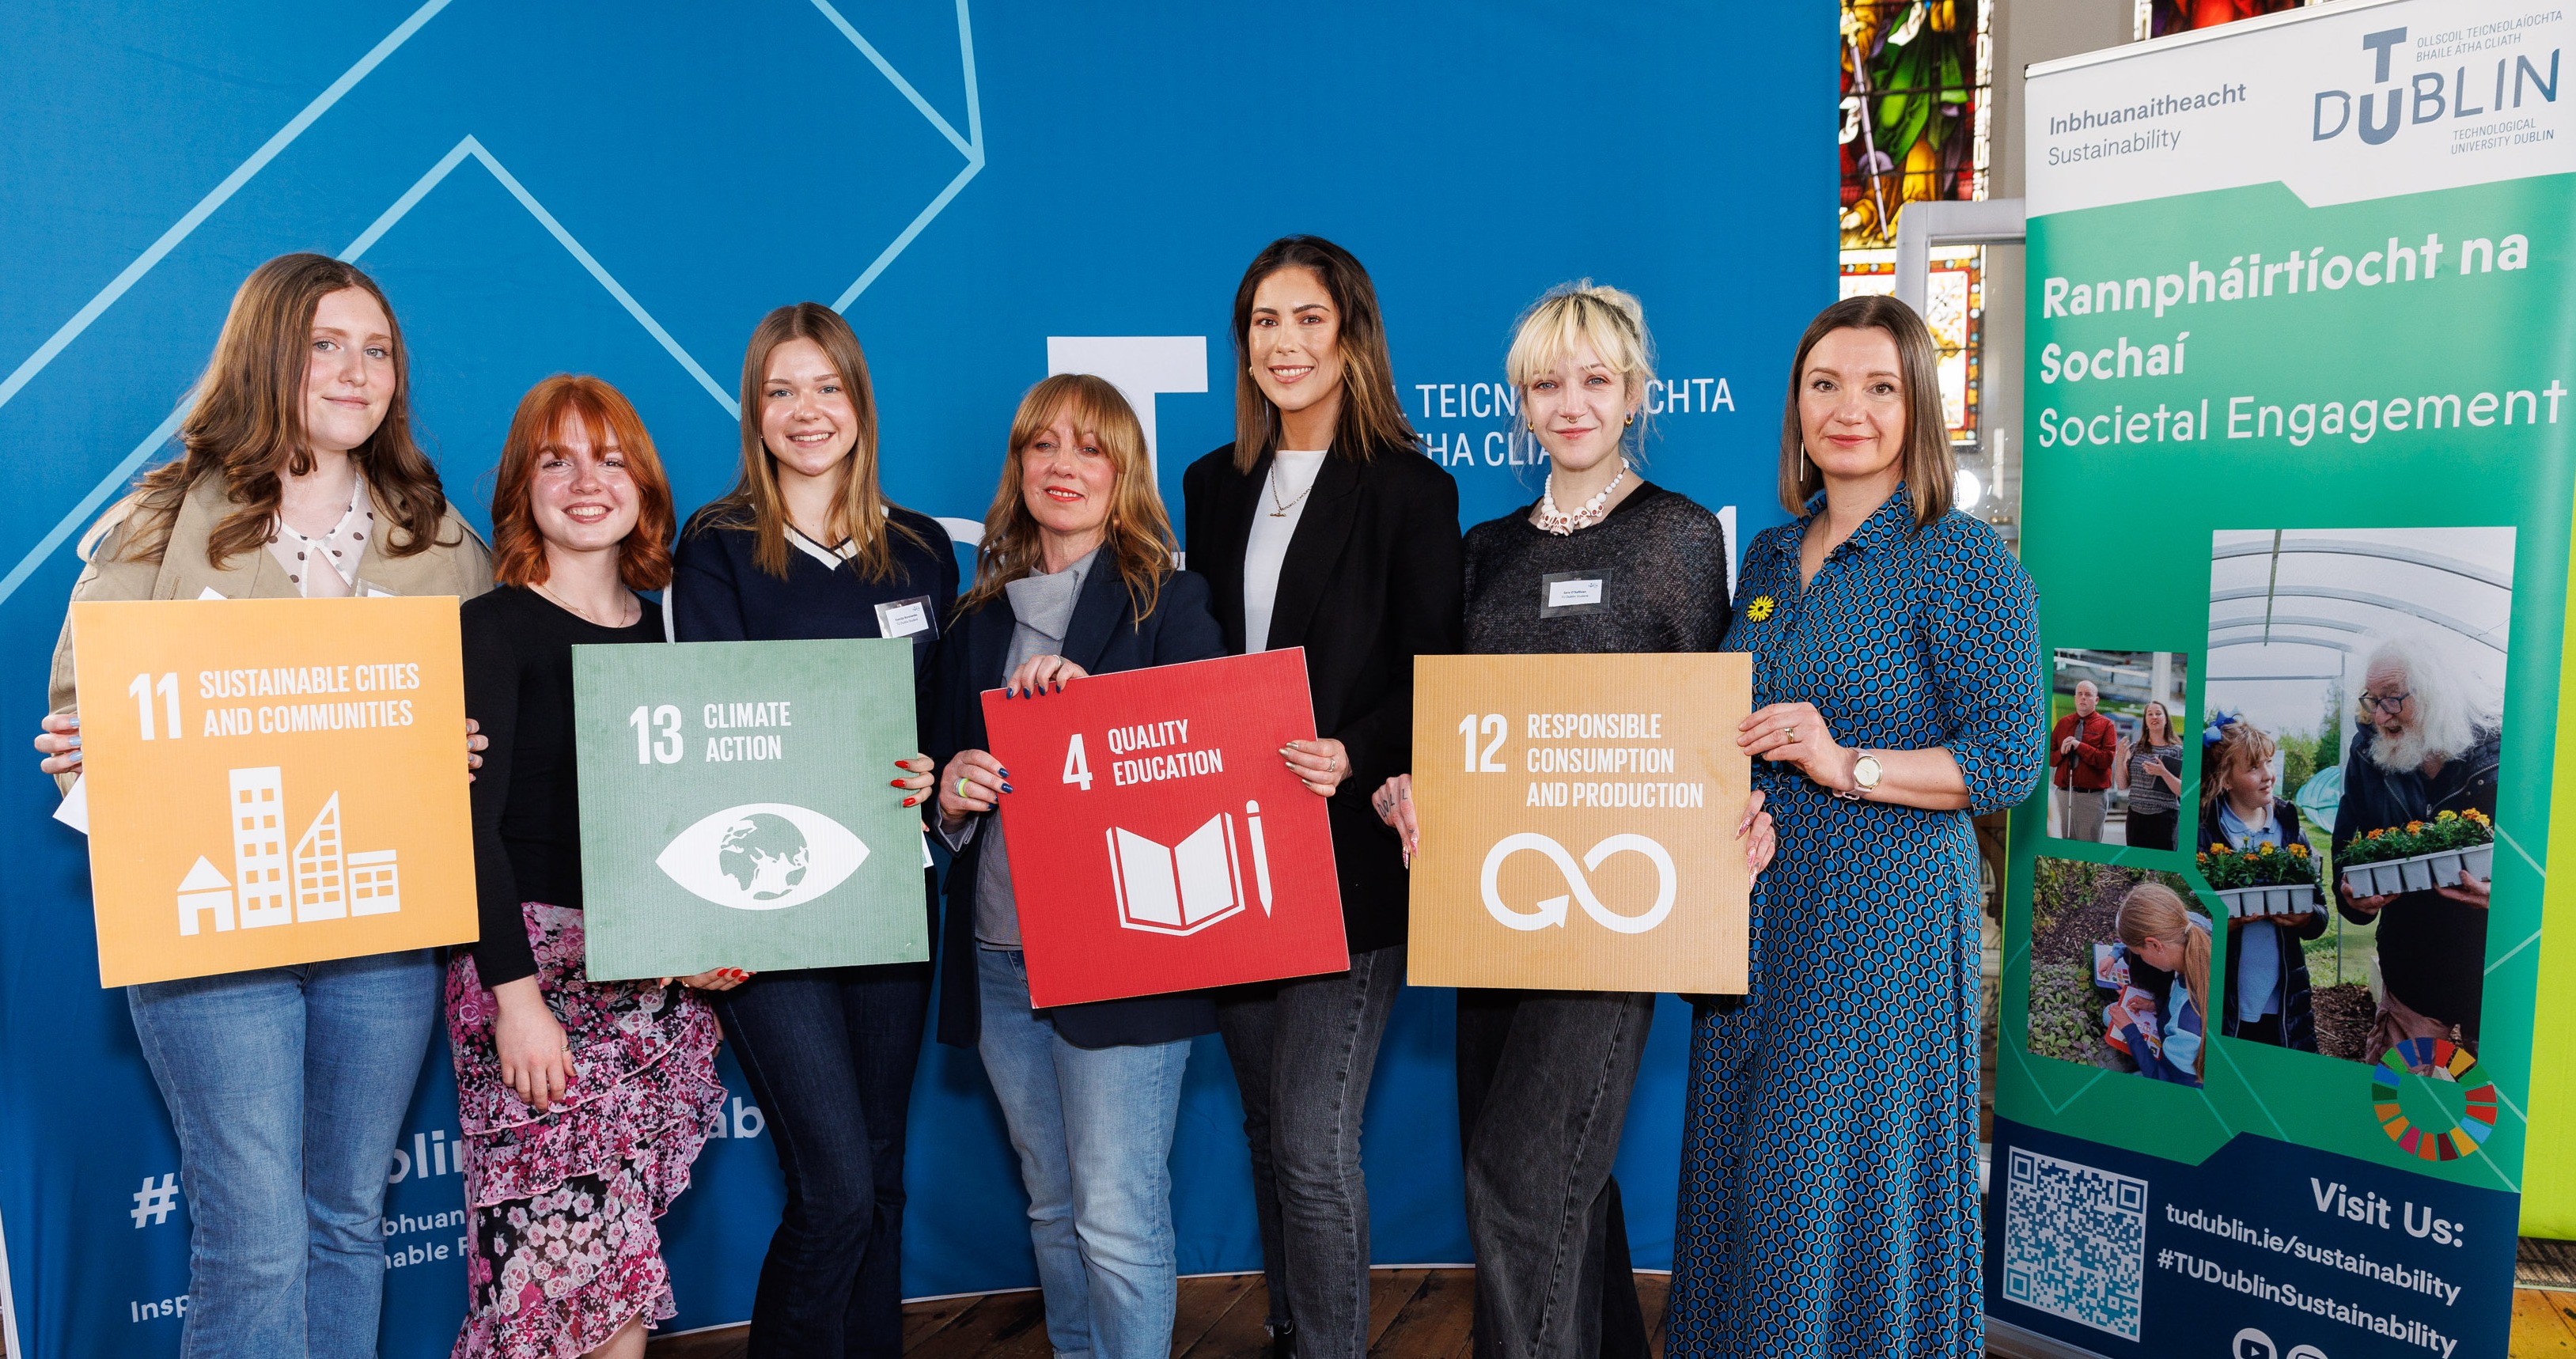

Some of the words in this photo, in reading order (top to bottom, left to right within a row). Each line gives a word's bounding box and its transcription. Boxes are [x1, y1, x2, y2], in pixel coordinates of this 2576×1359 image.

[2416, 44, 2452, 62] BHAILE
[2454, 41, 2482, 56] ÁTHA
[2484, 33, 2521, 50] CLIATH
[2417, 32, 2464, 47] OLLSCOIL
[2466, 10, 2563, 39] TEICNEOLAÍOCHTA
[2049, 83, 2246, 135] Inbhuanaitheacht
[2048, 129, 2181, 165] Sustainability
[2451, 135, 2510, 154] UNIVERSITY
[2513, 130, 2554, 146] DUBLIN
[2453, 118, 2536, 140] TECHNOLOGICAL
[2043, 233, 2443, 319] Rannpháirtíocht
[2460, 234, 2529, 276] na
[2040, 331, 2190, 384] Sochaí
[2039, 399, 2208, 448] Societal
[2227, 379, 2568, 446] Engagement
[199, 665, 350, 698] SUSTAINABLE
[355, 663, 419, 692] CITIES
[129, 672, 182, 741] 11
[203, 707, 252, 737] AND
[258, 699, 413, 734] COMMUNITIES
[703, 702, 791, 729] CLIMATE
[630, 704, 684, 765] 13
[1108, 718, 1188, 755] QUALITY
[1458, 714, 1507, 773] 12
[1527, 714, 1661, 739] RESPONSIBLE
[706, 735, 782, 762] ACTION
[1063, 733, 1093, 791] 4
[1112, 748, 1223, 786] EDUCATION
[1527, 748, 1674, 773] CONSUMPTION
[1526, 782, 1568, 807] AND
[1573, 782, 1703, 808] PRODUCTION
[2310, 1177, 2391, 1229] Visit
[2404, 1202, 2464, 1247] Us:
[2165, 1203, 2461, 1306] tudublin.ie/sustainability
[2157, 1248, 2457, 1359] #TUDublinSustainability
